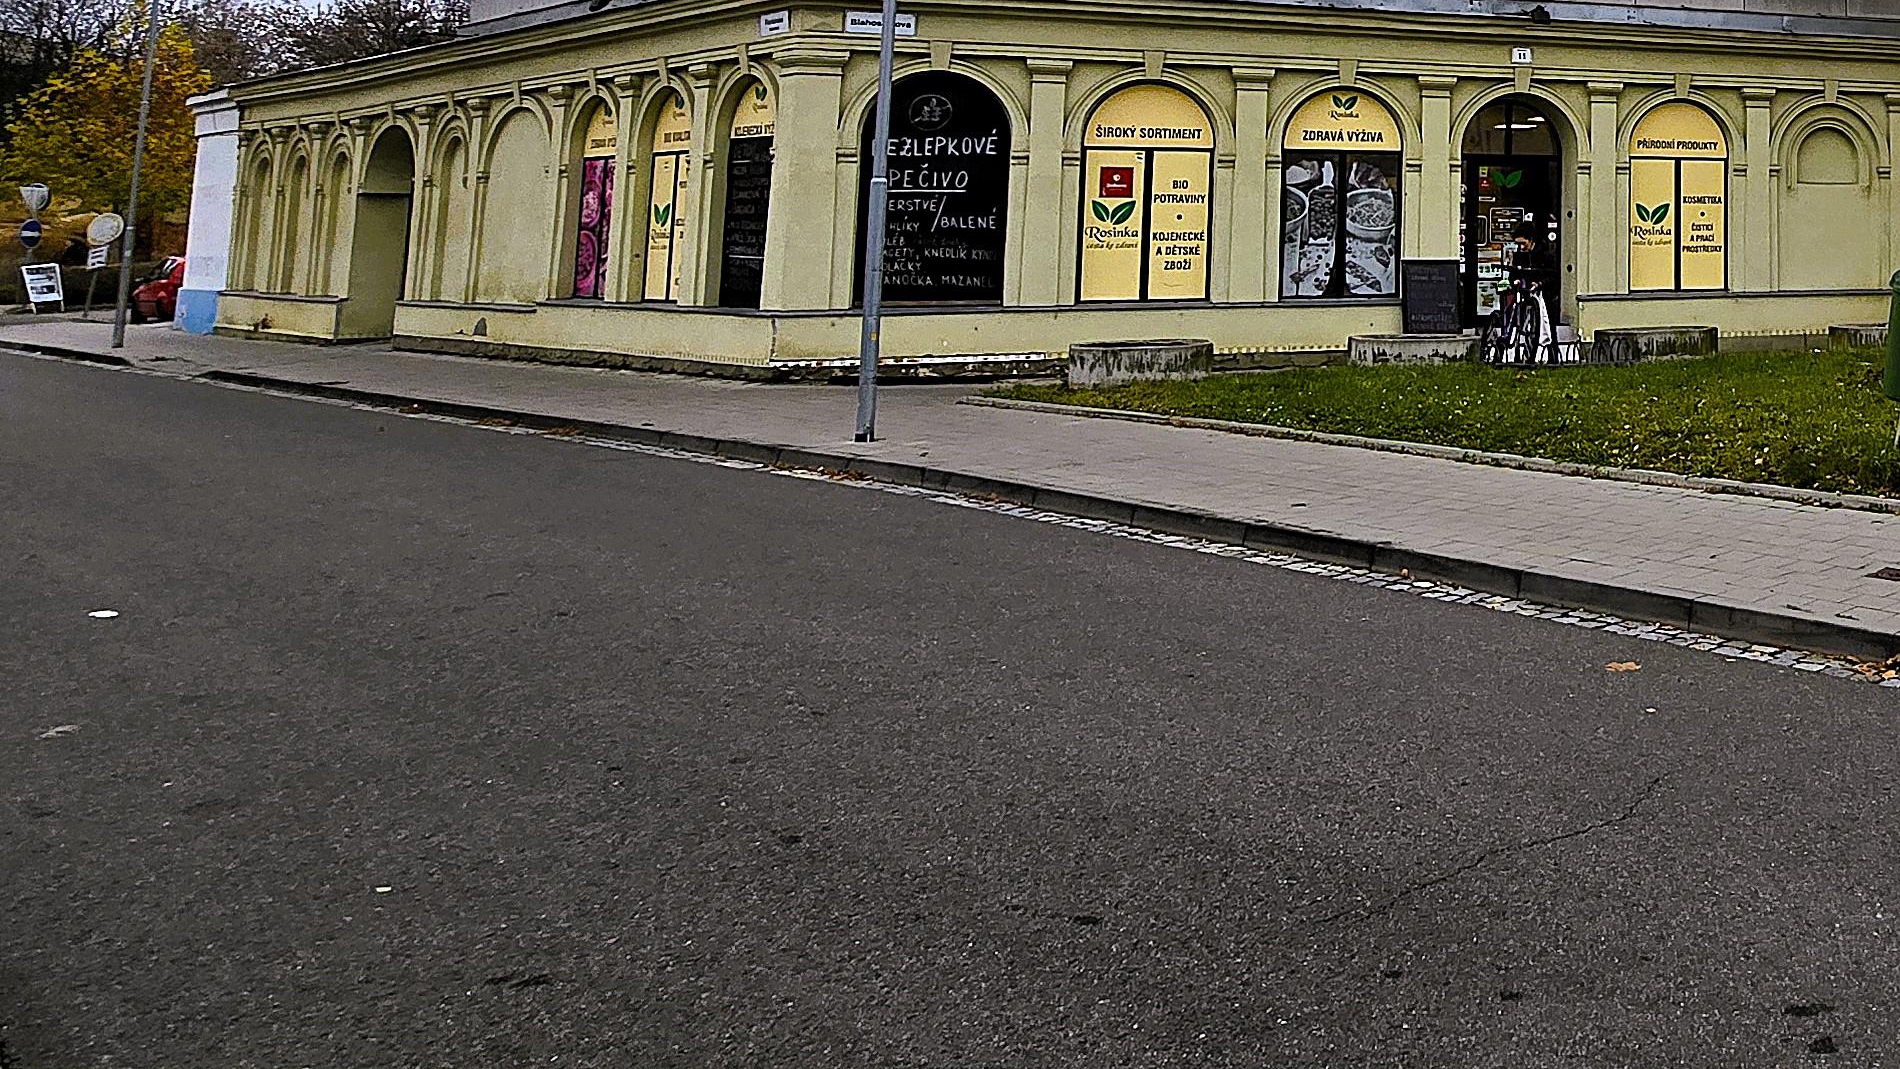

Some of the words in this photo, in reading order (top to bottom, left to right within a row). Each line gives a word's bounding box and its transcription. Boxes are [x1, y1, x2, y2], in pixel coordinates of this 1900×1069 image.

[1095, 124, 1136, 138] ŠIROKÝ
[1139, 127, 1203, 140] SORTIMENT
[1302, 129, 1344, 142] ZDRAVÁ
[1347, 129, 1384, 143] VÝŽIVA
[872, 129, 998, 156] EZLEPKOVÉ
[888, 163, 969, 188] PEČIVO
[1172, 180, 1189, 190] BIO
[888, 194, 938, 212] ERSTVÉ
[1153, 194, 1206, 204] POTRAVINY
[1085, 226, 1139, 243] Rosinka
[1152, 230, 1205, 242] KOJENECKÉ
[1631, 225, 1672, 240] Rosinka
[1156, 246, 1163, 256] A
[1163, 259, 1192, 271] ZBOŽÍ
